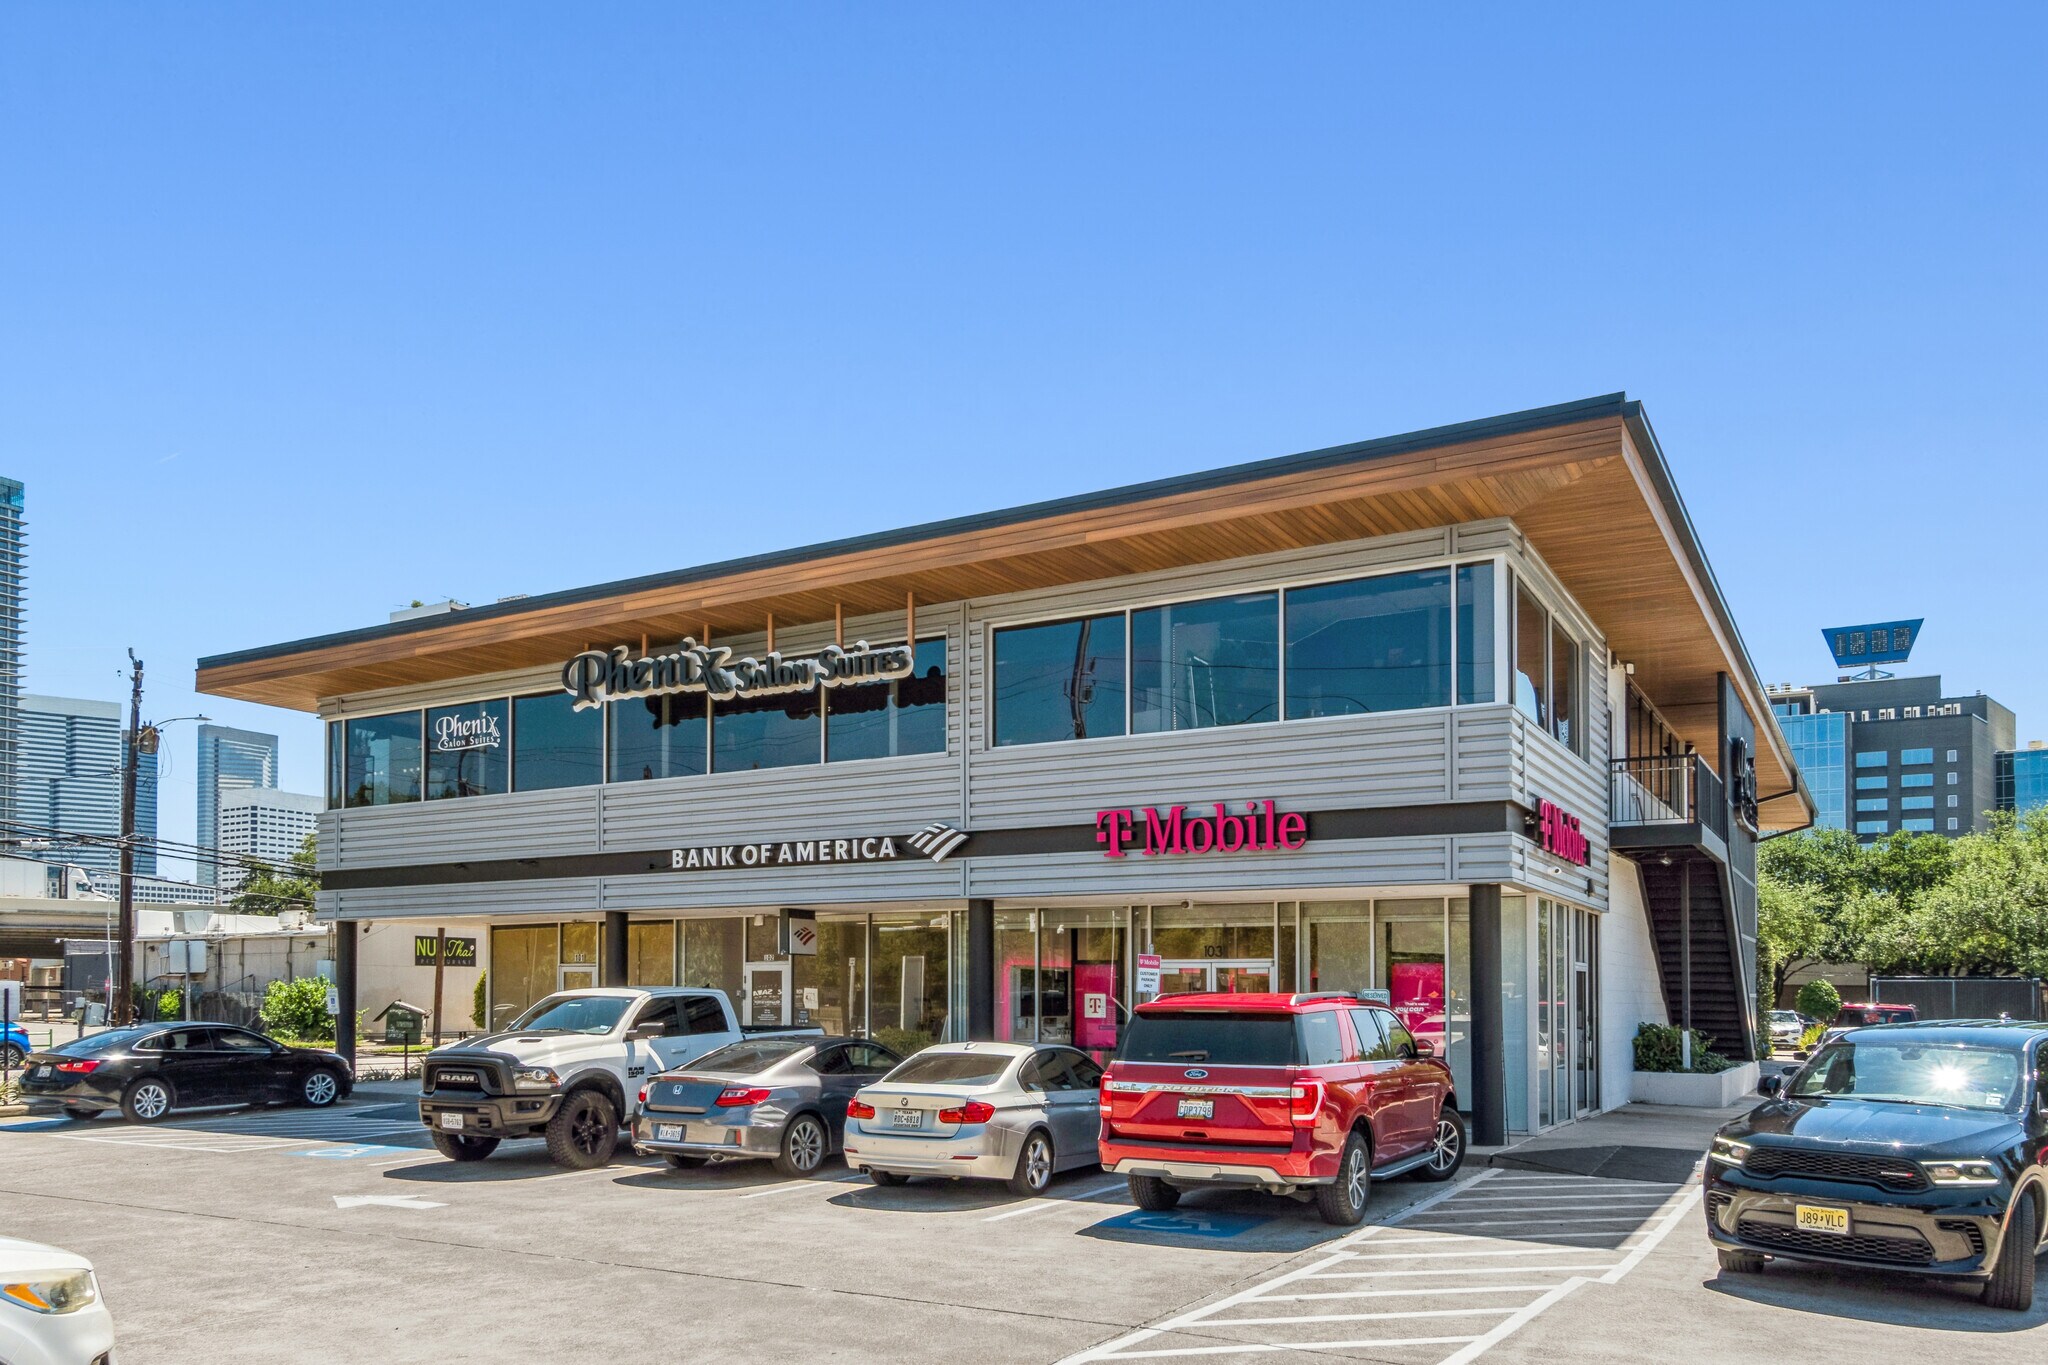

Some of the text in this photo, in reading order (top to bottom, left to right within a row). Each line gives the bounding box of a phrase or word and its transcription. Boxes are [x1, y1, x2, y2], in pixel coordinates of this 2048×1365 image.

[562, 640, 734, 706] Phenix
[436, 711, 500, 740] Phenix
[1142, 800, 1307, 854] Mobile
[672, 837, 897, 869] BANK OF AMERICA
[416, 938, 475, 956] NU Thai
[1204, 945, 1222, 957] 103
[440, 1074, 475, 1082] RAM
[1155, 1085, 1235, 1093] EXPEDITION
